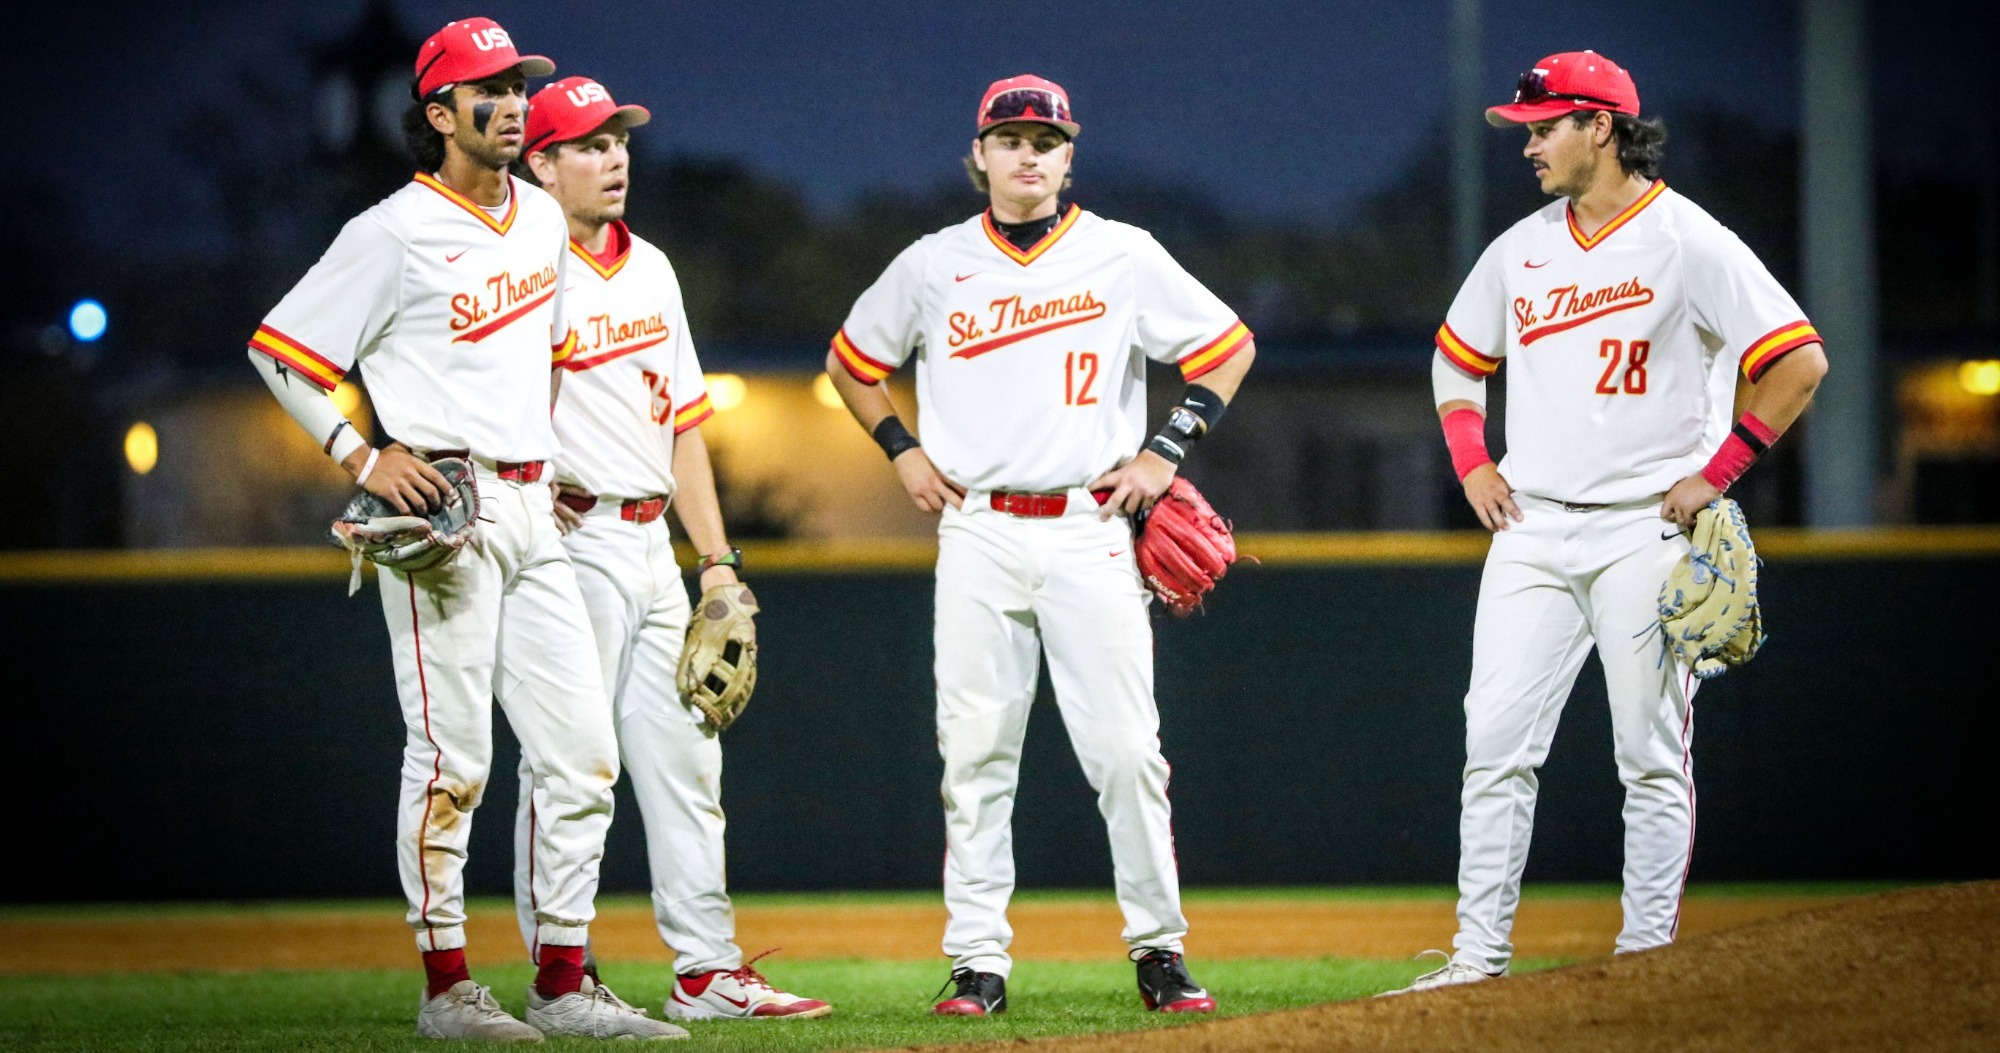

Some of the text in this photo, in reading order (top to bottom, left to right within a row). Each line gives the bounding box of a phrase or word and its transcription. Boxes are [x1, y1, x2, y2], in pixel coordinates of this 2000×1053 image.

[450, 262, 557, 331] St. Thomas
[949, 290, 1107, 347] St. Thomas
[1514, 276, 1655, 333] St. Thomas
[573, 313, 669, 354] t. Thomas
[1064, 351, 1099, 406] 12
[1595, 338, 1650, 395] 28
